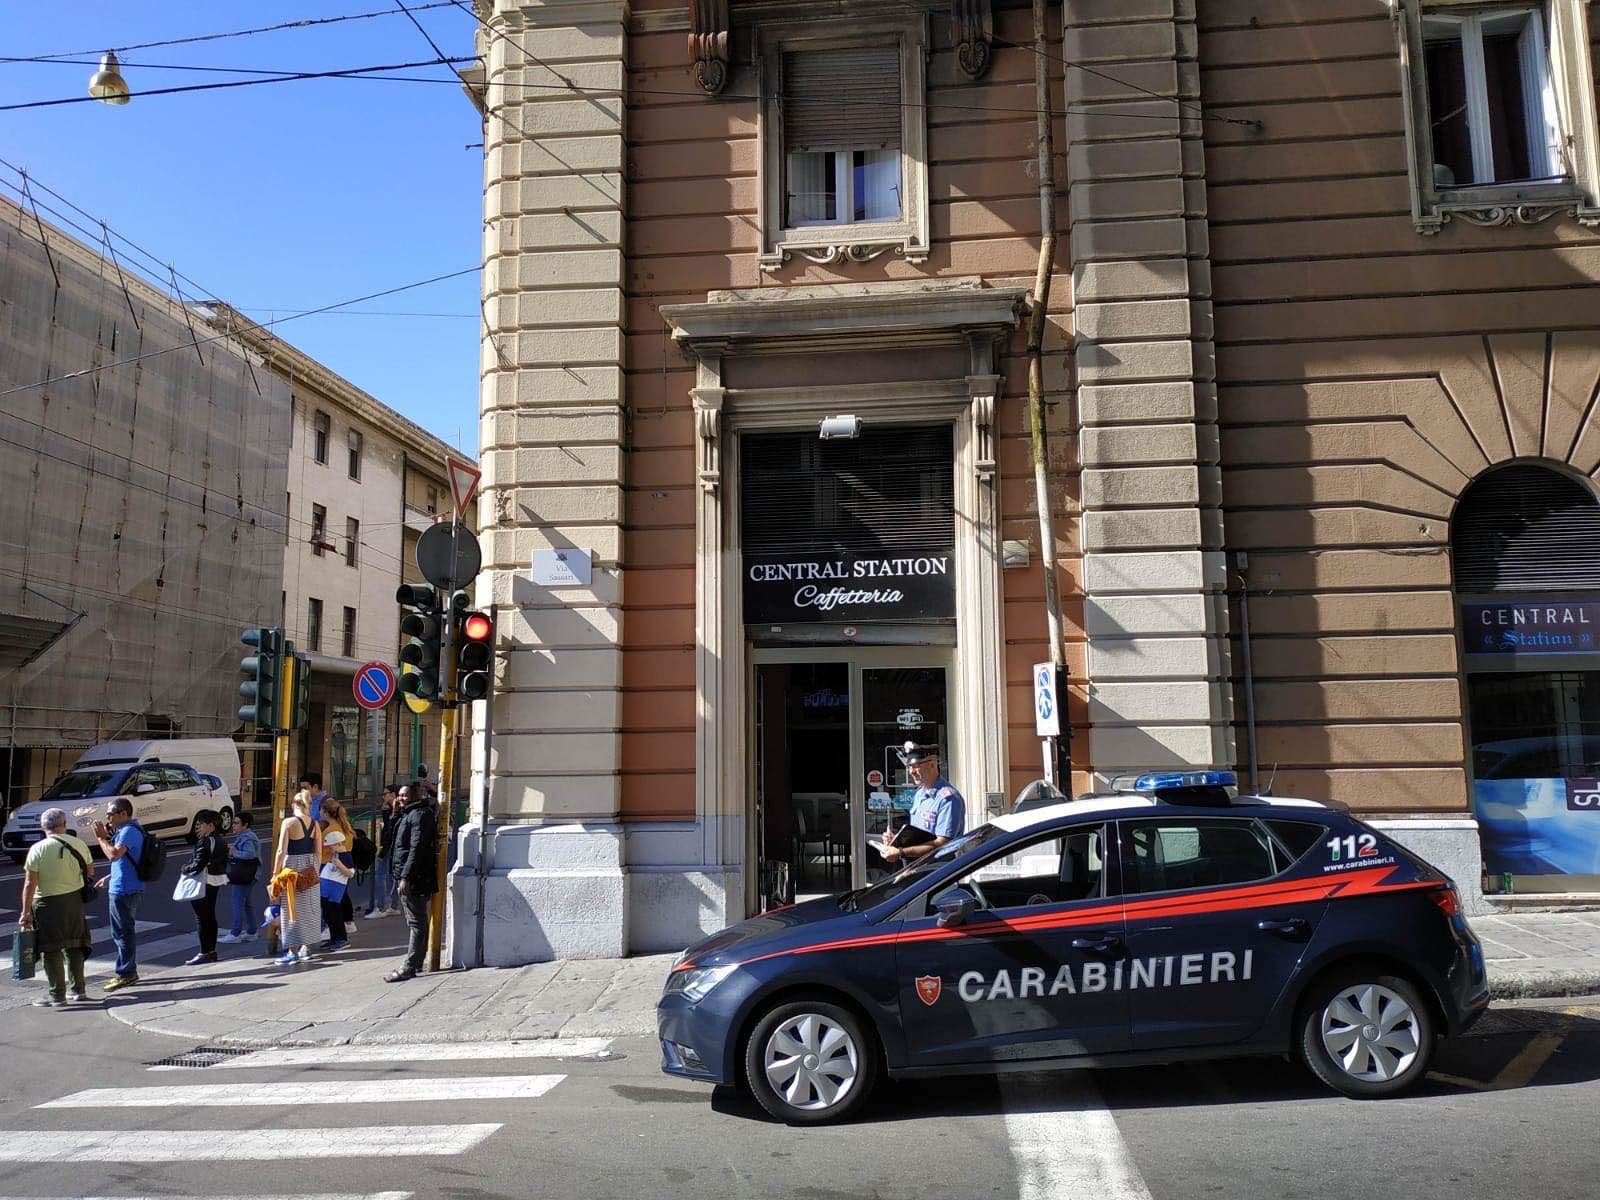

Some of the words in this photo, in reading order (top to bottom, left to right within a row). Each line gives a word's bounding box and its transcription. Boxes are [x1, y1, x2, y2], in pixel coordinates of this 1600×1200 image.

[750, 561, 849, 581] CENTRAL
[853, 557, 947, 577] STATION
[794, 585, 904, 610] Caffetteria
[1481, 608, 1590, 625] CENTRAL
[1499, 630, 1573, 648] Station
[1326, 833, 1379, 861] 112
[1323, 856, 1395, 872] www.carabinieri.it
[958, 948, 1254, 1003] CARABINIERI
